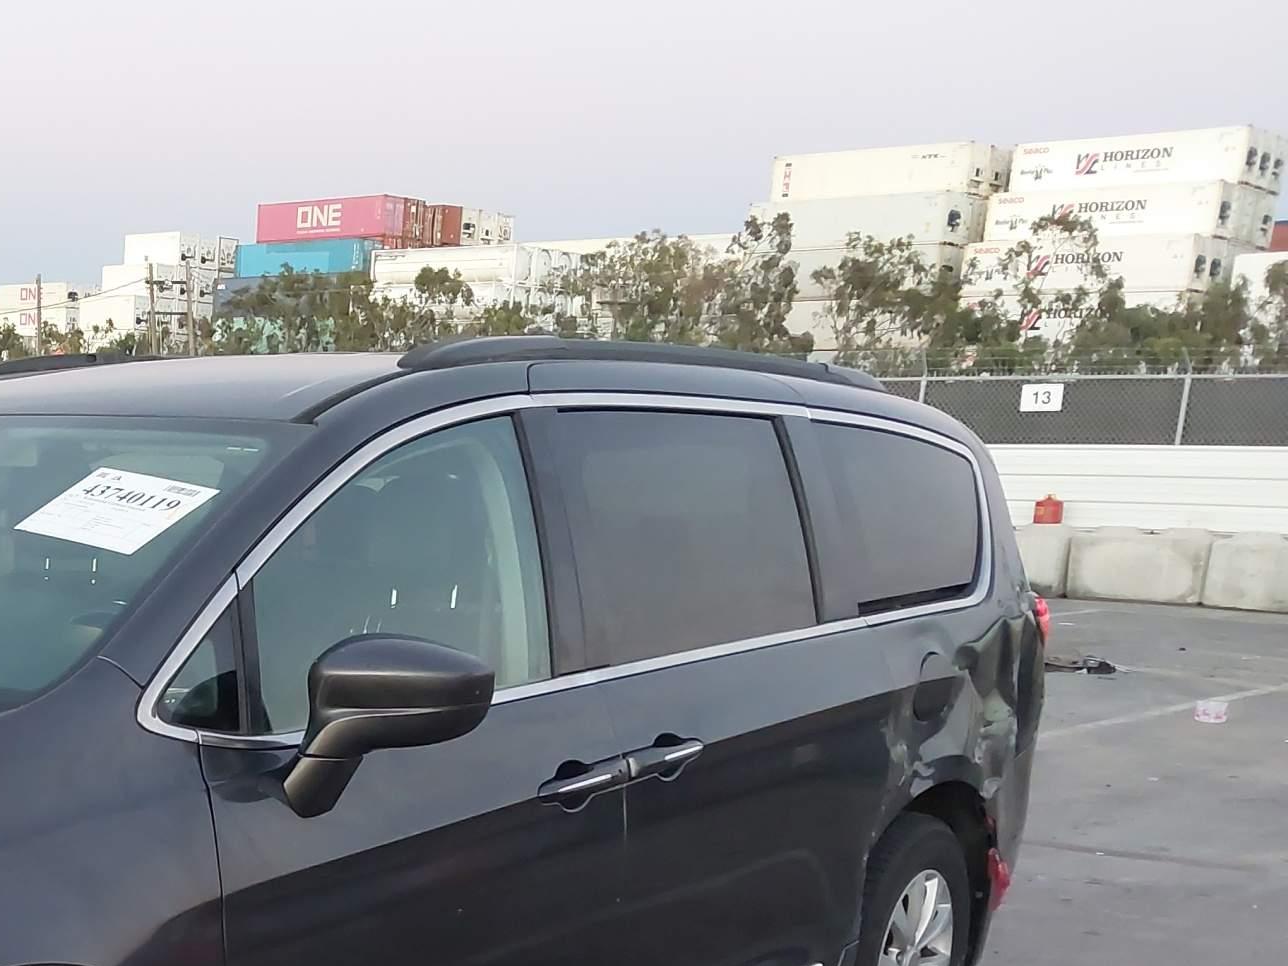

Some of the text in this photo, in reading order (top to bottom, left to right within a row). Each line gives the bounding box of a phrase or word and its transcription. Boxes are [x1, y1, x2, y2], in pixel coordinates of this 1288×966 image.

[1102, 146, 1174, 163] HORIZON
[1100, 160, 1161, 171] LINES
[1077, 199, 1147, 214] HORIZON
[296, 203, 342, 229] ONE
[1032, 390, 1052, 405] 13
[82, 483, 181, 511] 43740119
